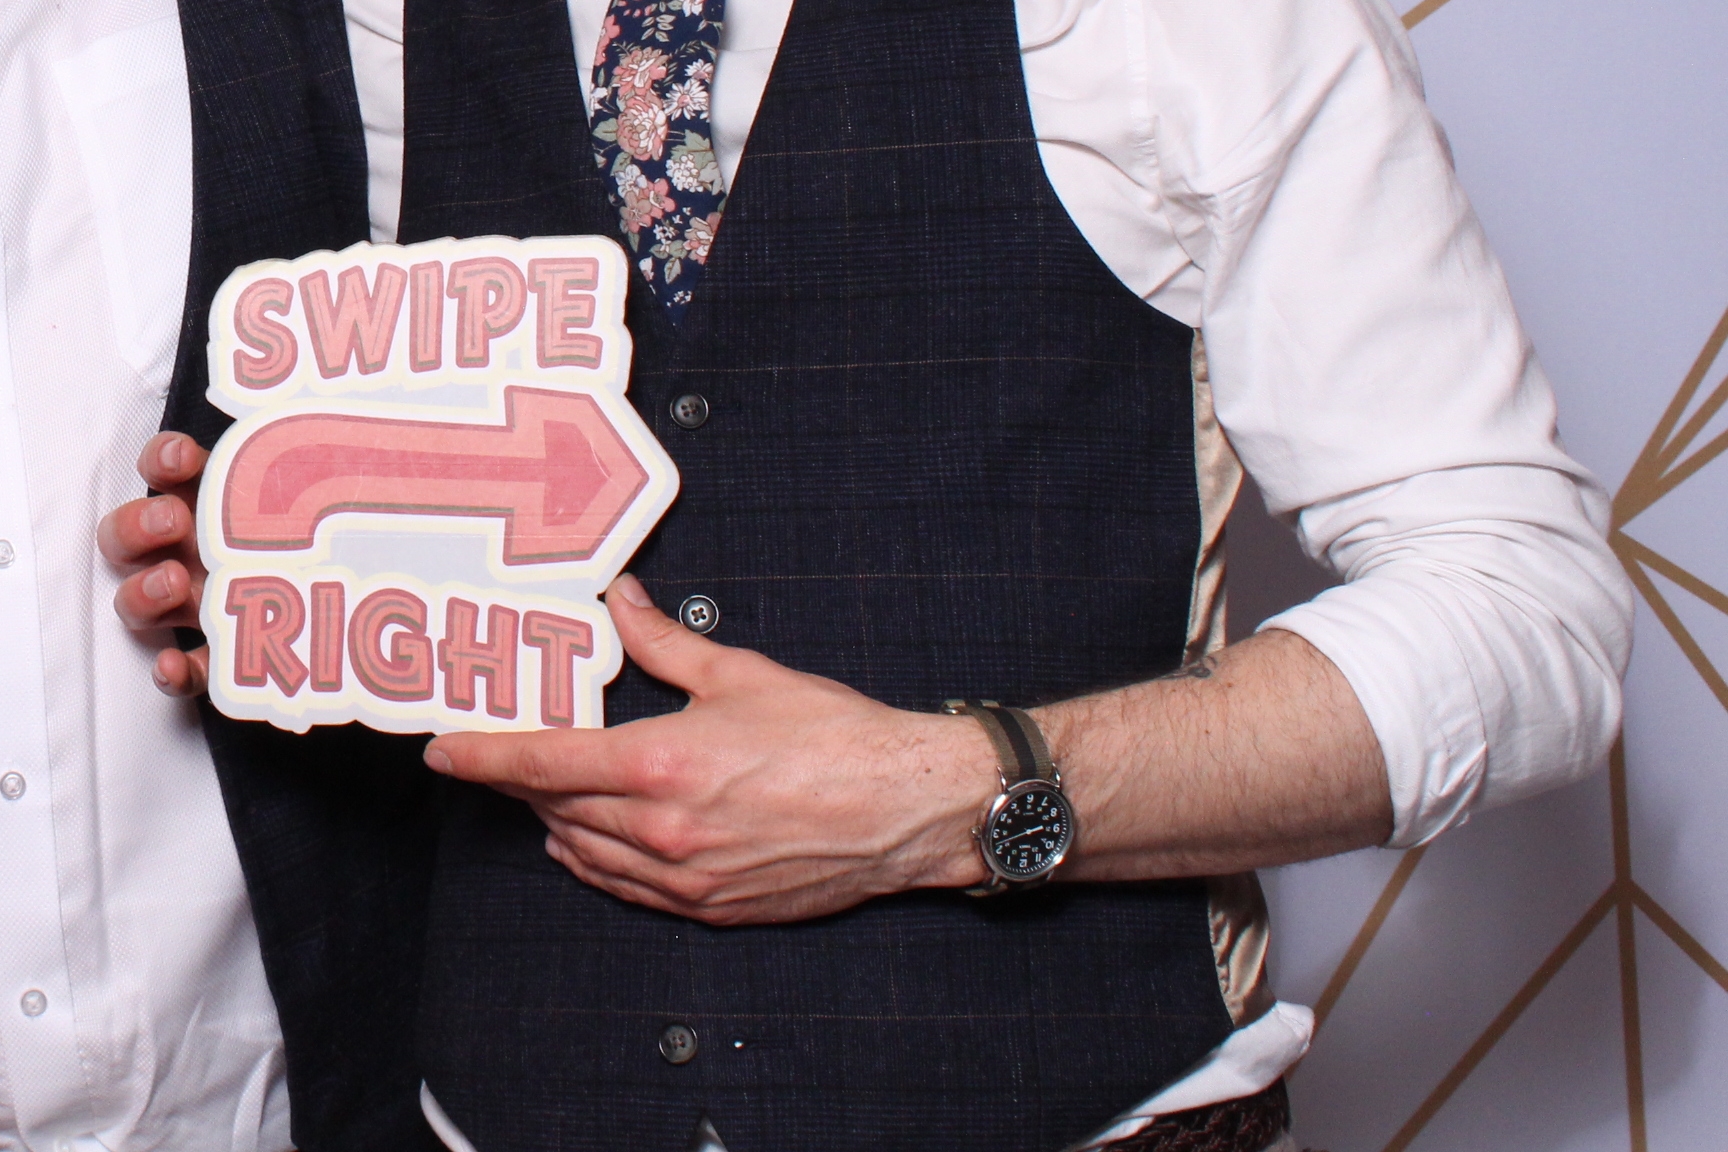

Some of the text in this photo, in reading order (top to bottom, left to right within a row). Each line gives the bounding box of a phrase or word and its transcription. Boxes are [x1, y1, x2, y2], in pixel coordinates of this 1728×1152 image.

[233, 256, 603, 391] SWIPE
[225, 576, 594, 728] RIGHT
[1026, 794, 1034, 803] 6
[1041, 796, 1048, 806] 7
[1050, 807, 1058, 817] 8
[993, 828, 1000, 838] 3
[1053, 823, 1060, 833] 9
[995, 845, 1003, 854] 2
[1045, 840, 1055, 849] 10
[1019, 858, 1027, 867] 12
[1035, 853, 1042, 862] 11
